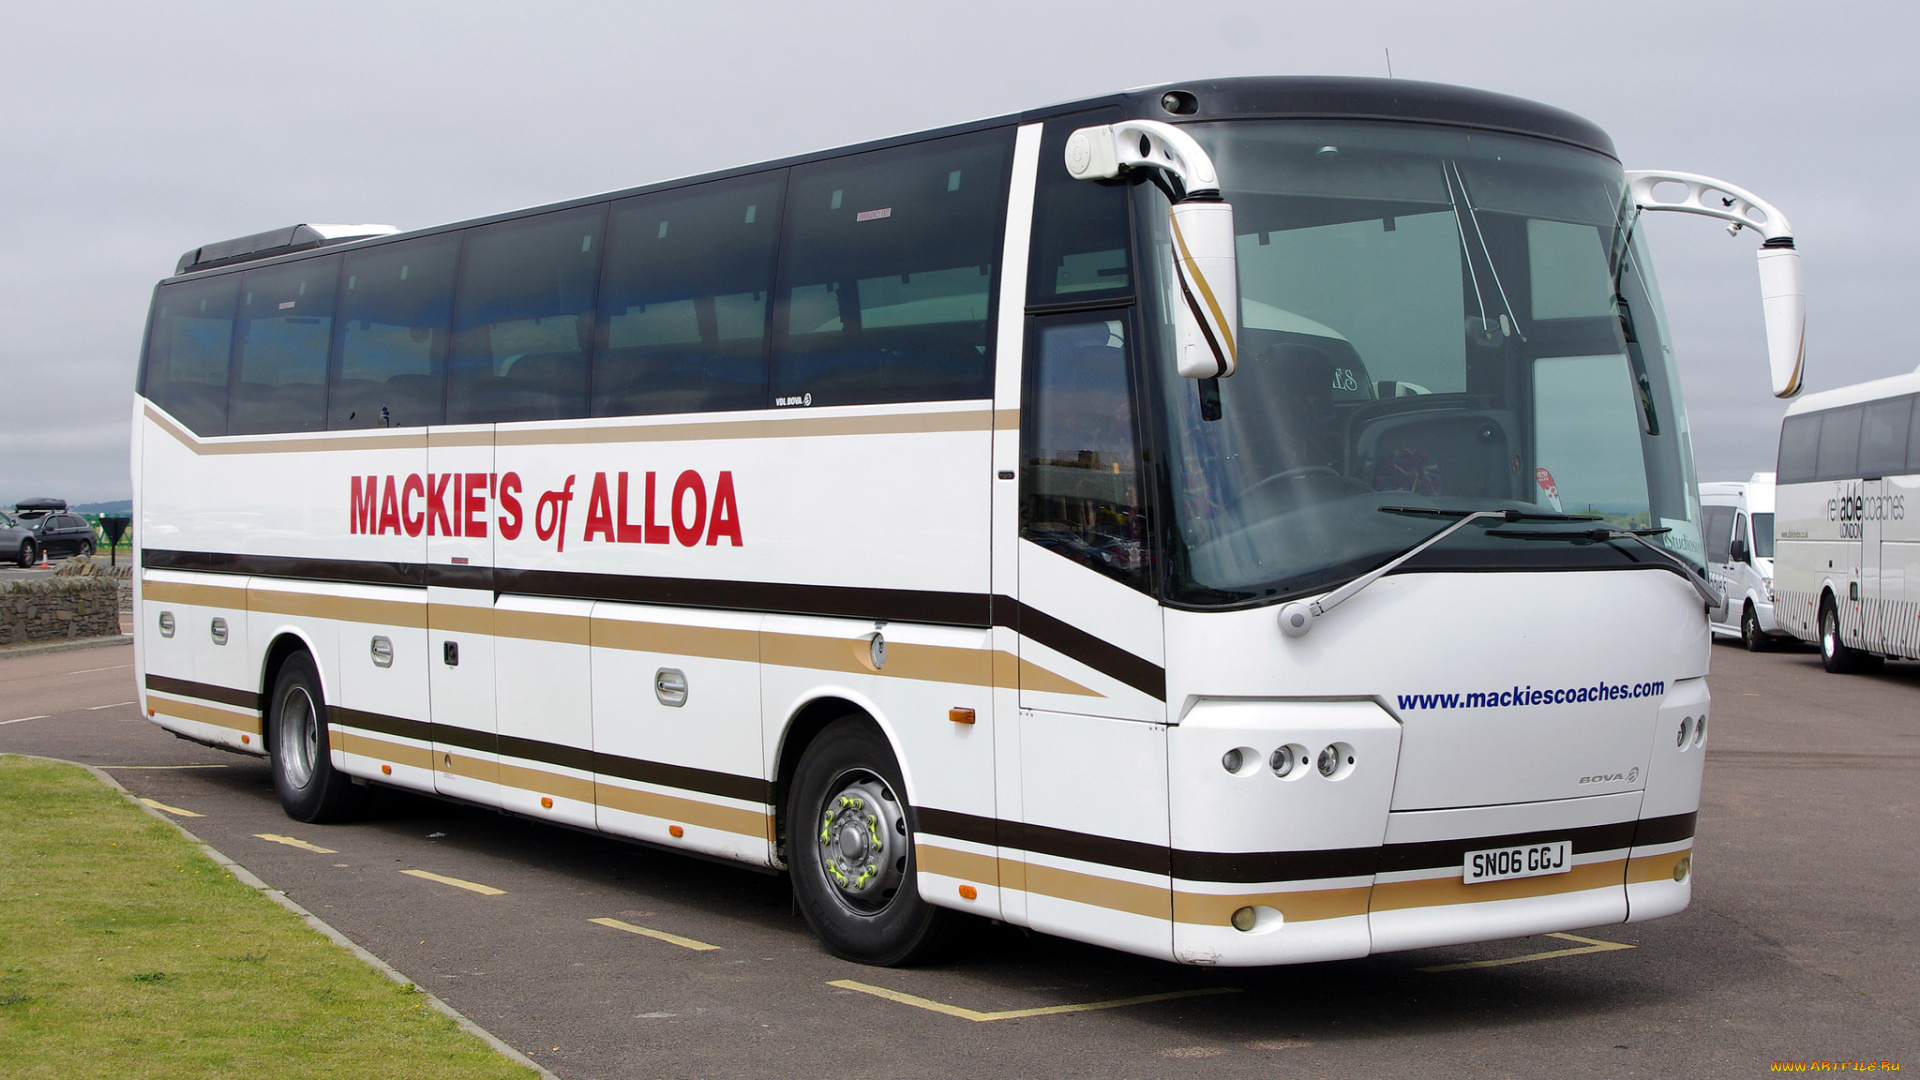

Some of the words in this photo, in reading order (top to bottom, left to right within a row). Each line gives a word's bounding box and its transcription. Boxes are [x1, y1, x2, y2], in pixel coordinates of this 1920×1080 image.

[775, 397, 787, 407] VDL
[787, 396, 803, 406] BOVA
[350, 471, 523, 541] MACKIE'S
[535, 474, 576, 553] of
[583, 469, 744, 548] ALLOA
[1840, 523, 1863, 539] LONDON
[1397, 680, 1665, 710] www.mackiescoaches.com
[1578, 773, 1624, 785] BOVA
[1472, 850, 1522, 878] SN06
[1528, 845, 1564, 871] GGJ
